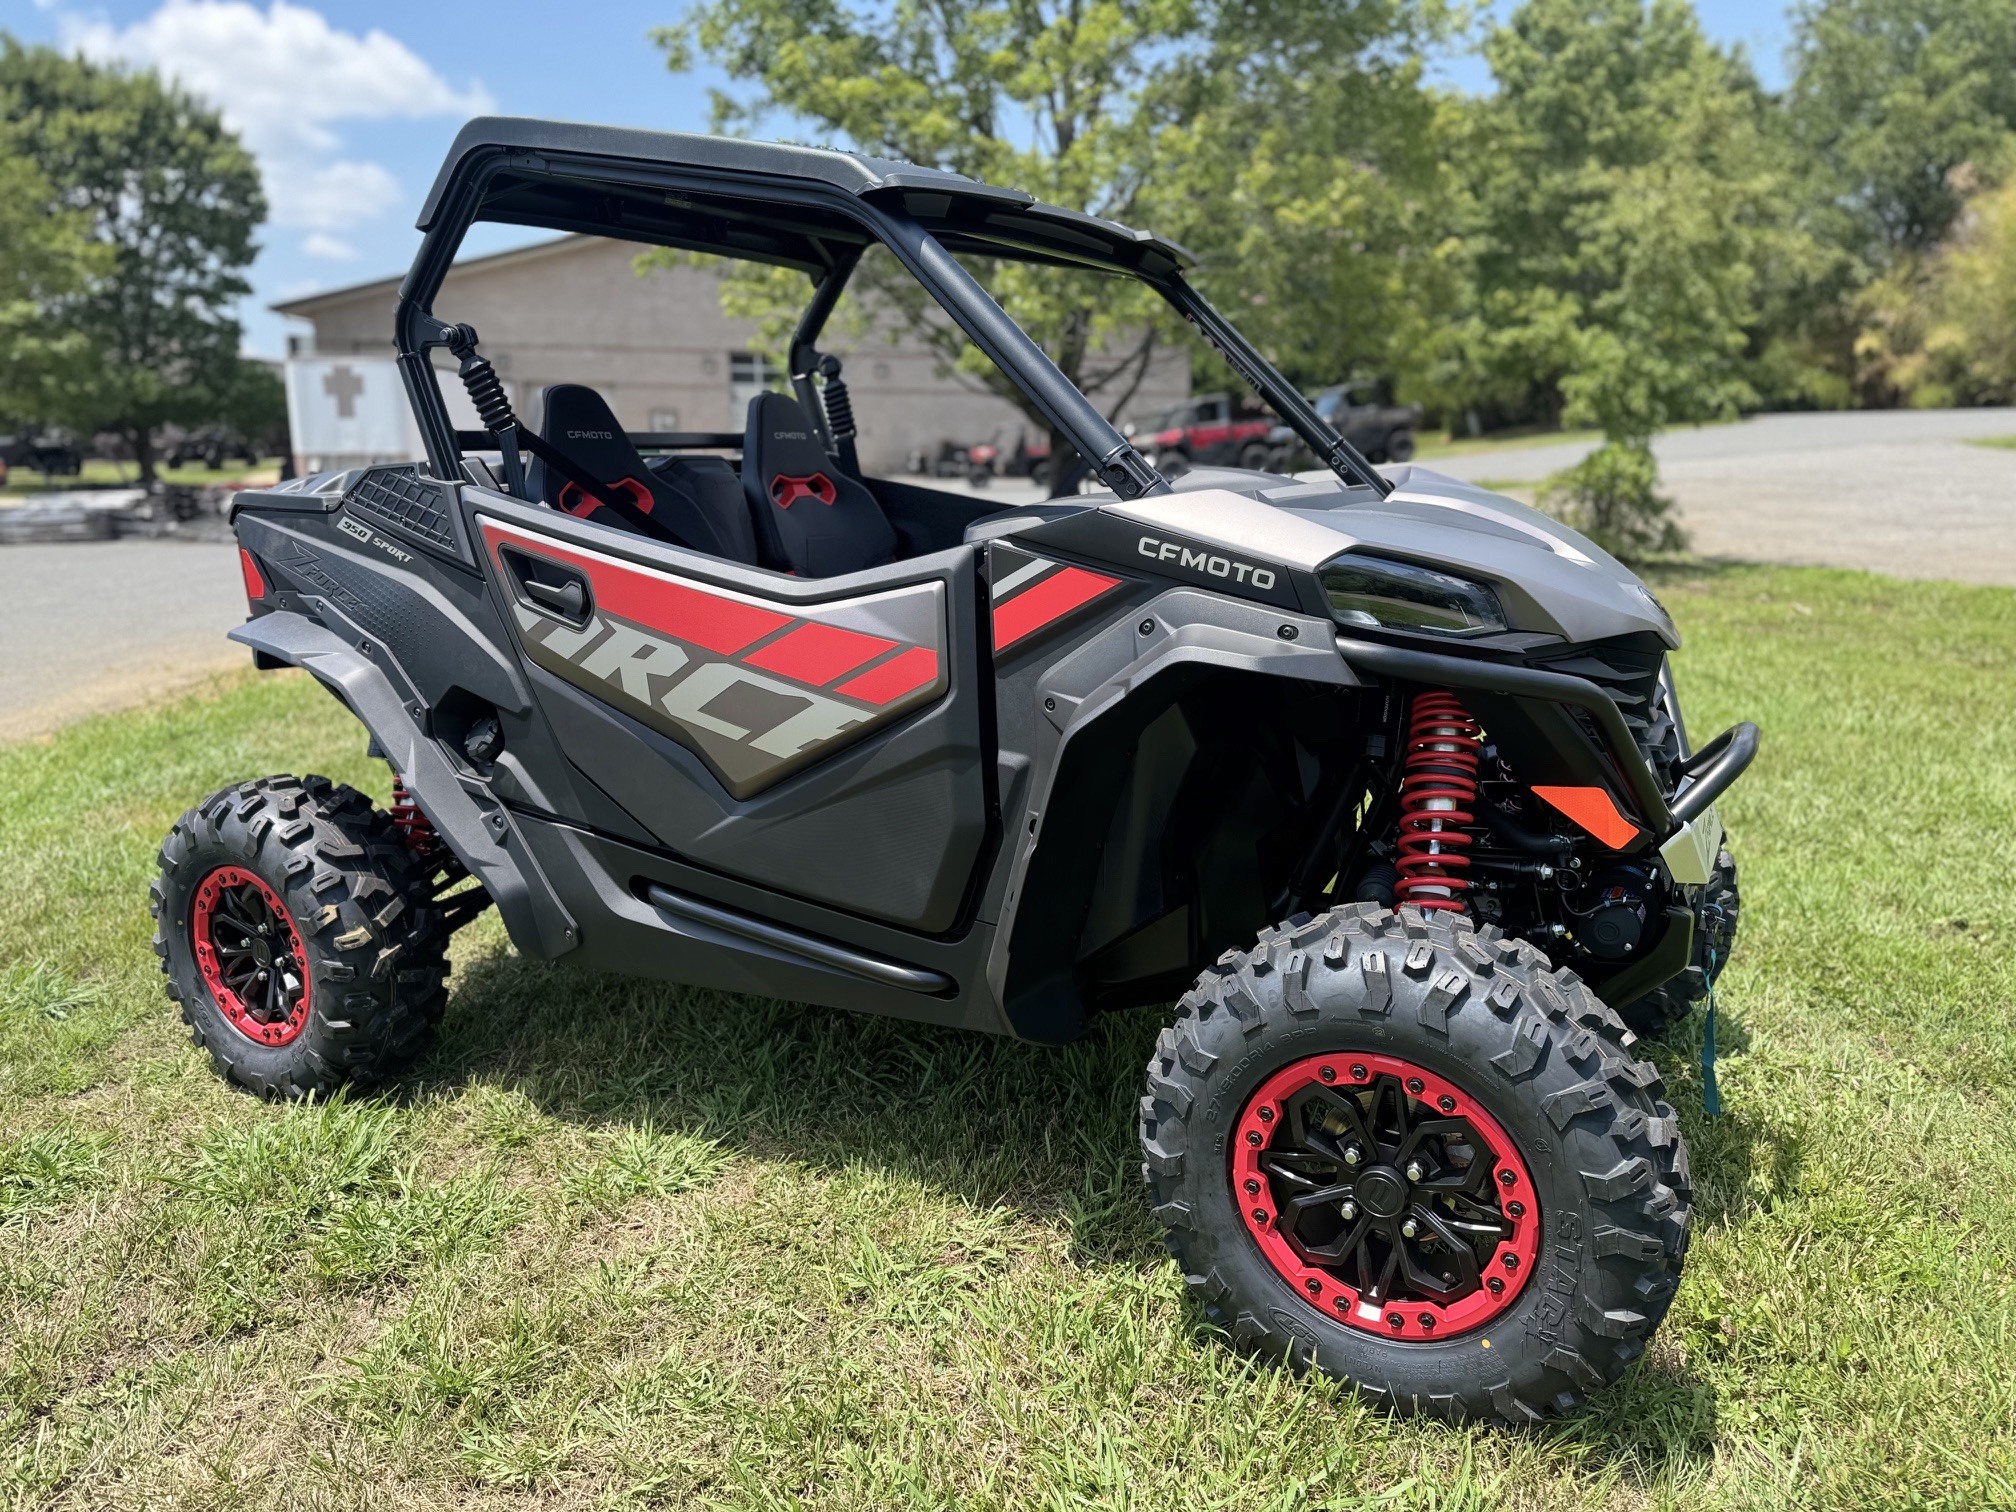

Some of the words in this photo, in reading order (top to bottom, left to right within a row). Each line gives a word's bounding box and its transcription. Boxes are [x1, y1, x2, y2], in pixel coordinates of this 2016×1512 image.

[567, 430, 613, 440] CFMOTO
[774, 431, 807, 441] CFMOTO
[343, 520, 368, 538] 950
[372, 537, 414, 562] SPORT
[1138, 536, 1276, 590] CFMOTO
[1534, 1209, 1583, 1327] STAG
